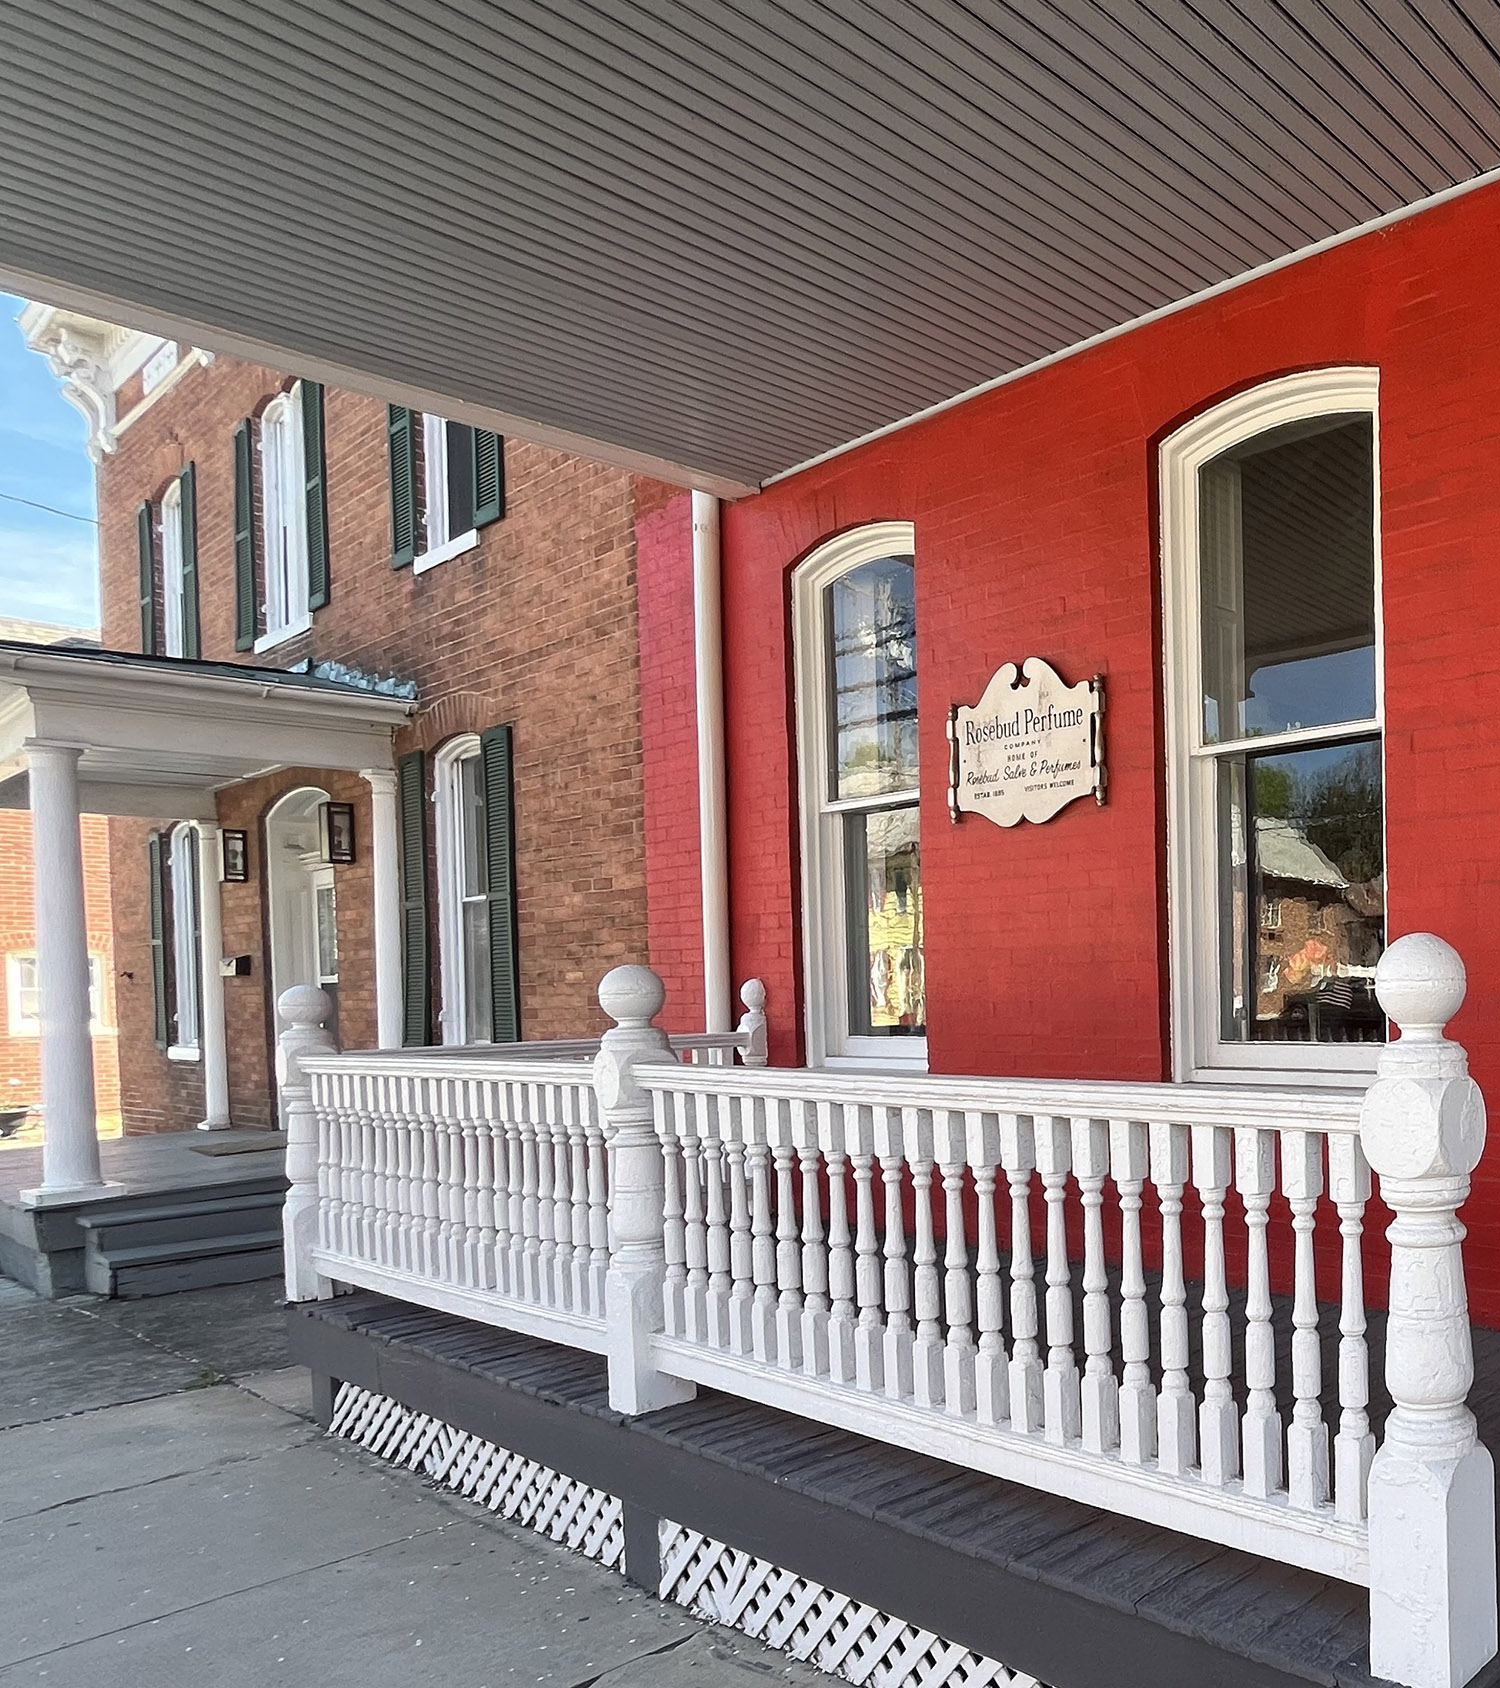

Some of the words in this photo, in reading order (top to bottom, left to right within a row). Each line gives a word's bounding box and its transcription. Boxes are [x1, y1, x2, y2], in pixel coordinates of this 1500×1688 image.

[965, 711, 1020, 746] Rosebud
[1024, 703, 1083, 735] Perfume
[1004, 739, 1041, 750] COMPANY
[1007, 752, 1026, 763] HOME
[1029, 750, 1038, 760] OF
[966, 769, 999, 786] Rosebud
[1003, 764, 1027, 781] Salve
[1029, 763, 1038, 776] &
[1039, 759, 1081, 779] Perfumes
[1024, 783, 1047, 792] VISITORS
[1049, 779, 1075, 789] WELCOME
